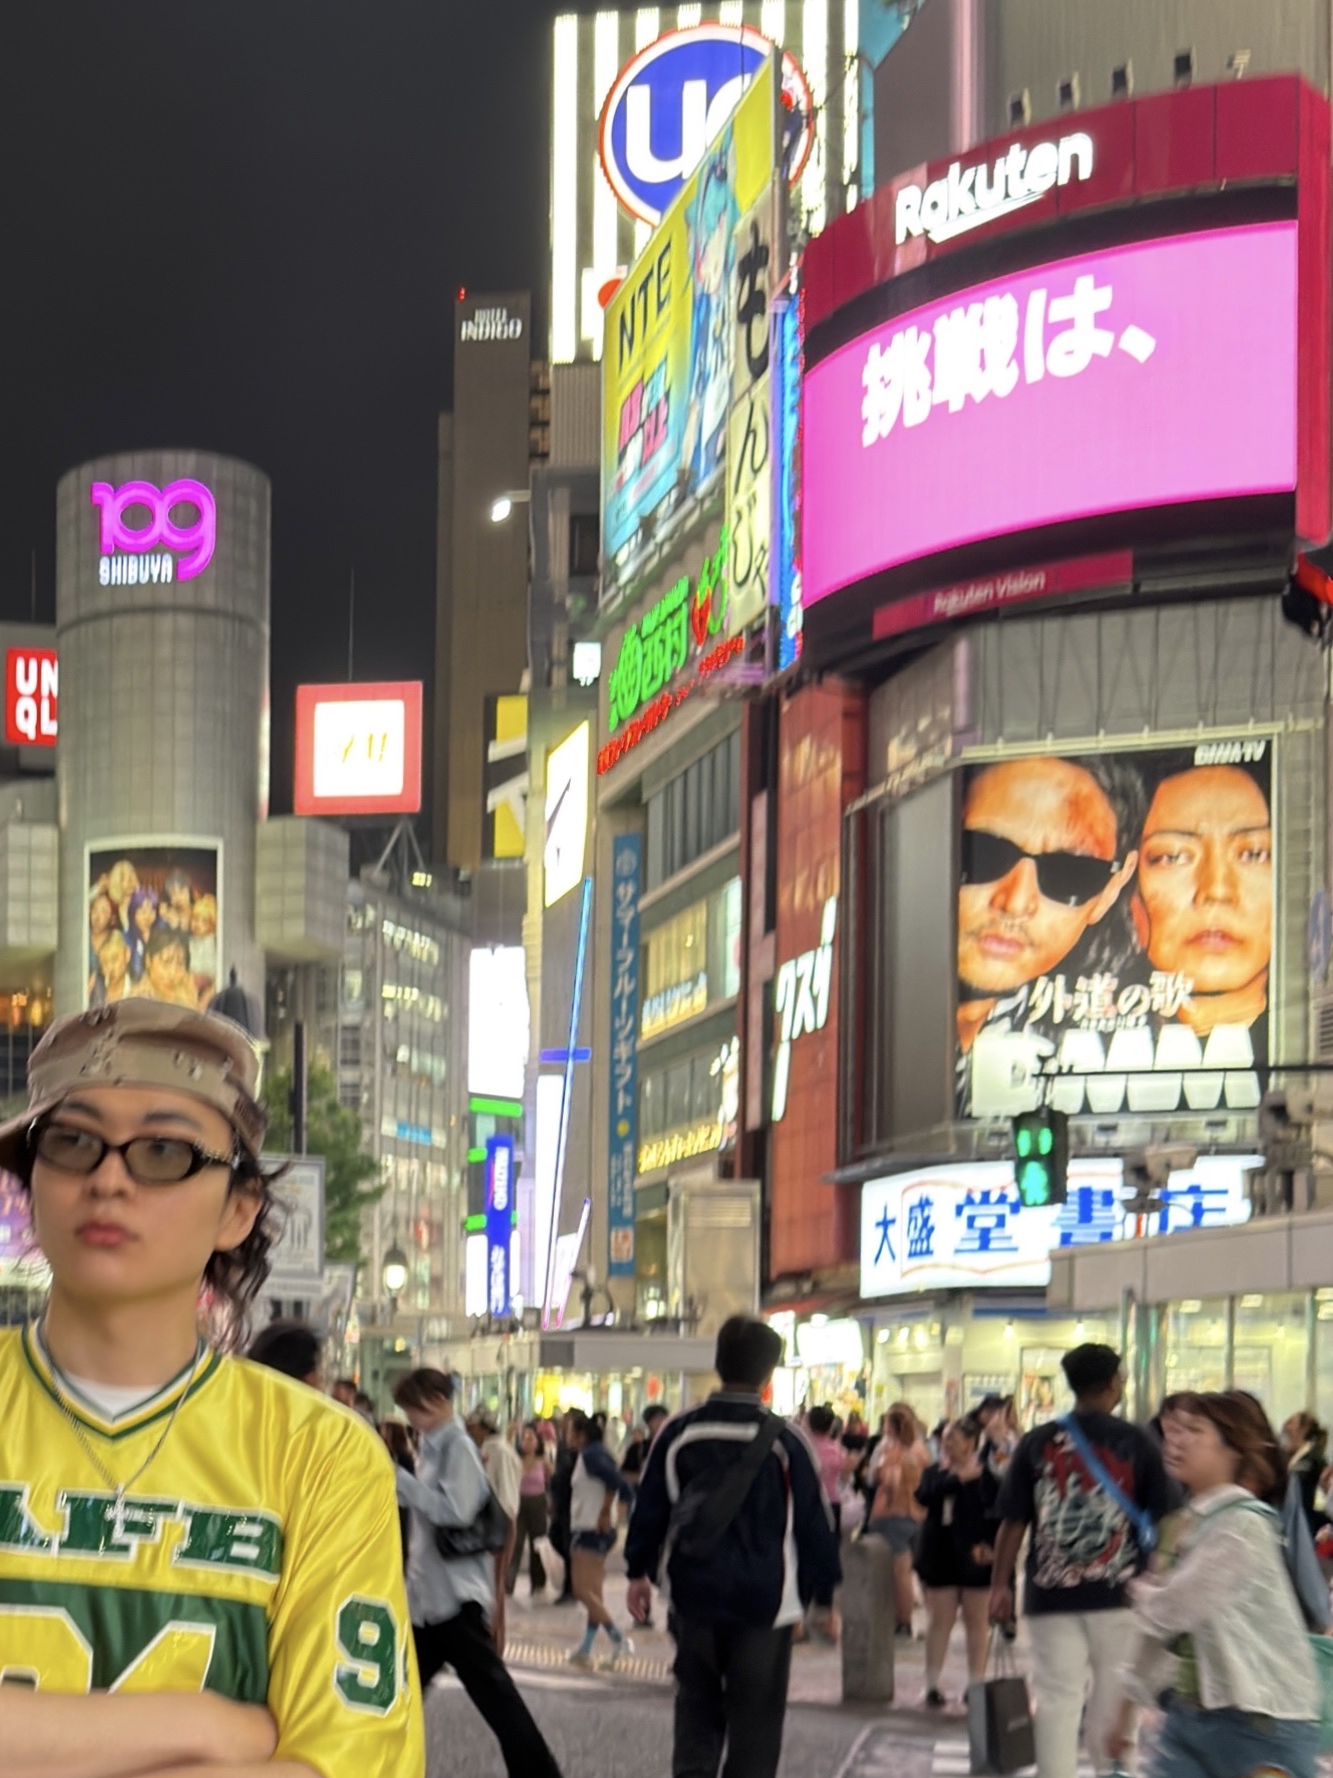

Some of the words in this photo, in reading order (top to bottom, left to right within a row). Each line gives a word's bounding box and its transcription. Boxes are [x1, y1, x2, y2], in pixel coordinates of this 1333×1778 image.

[625, 73, 753, 184] U
[895, 131, 1093, 245] Rakuten
[861, 274, 1156, 448] 挑戦は、
[91, 479, 216, 582] 109
[99, 553, 173, 586] SHIBUYA
[15, 656, 58, 698] UN
[15, 696, 58, 741] QL
[331, 1592, 405, 1718] 9
